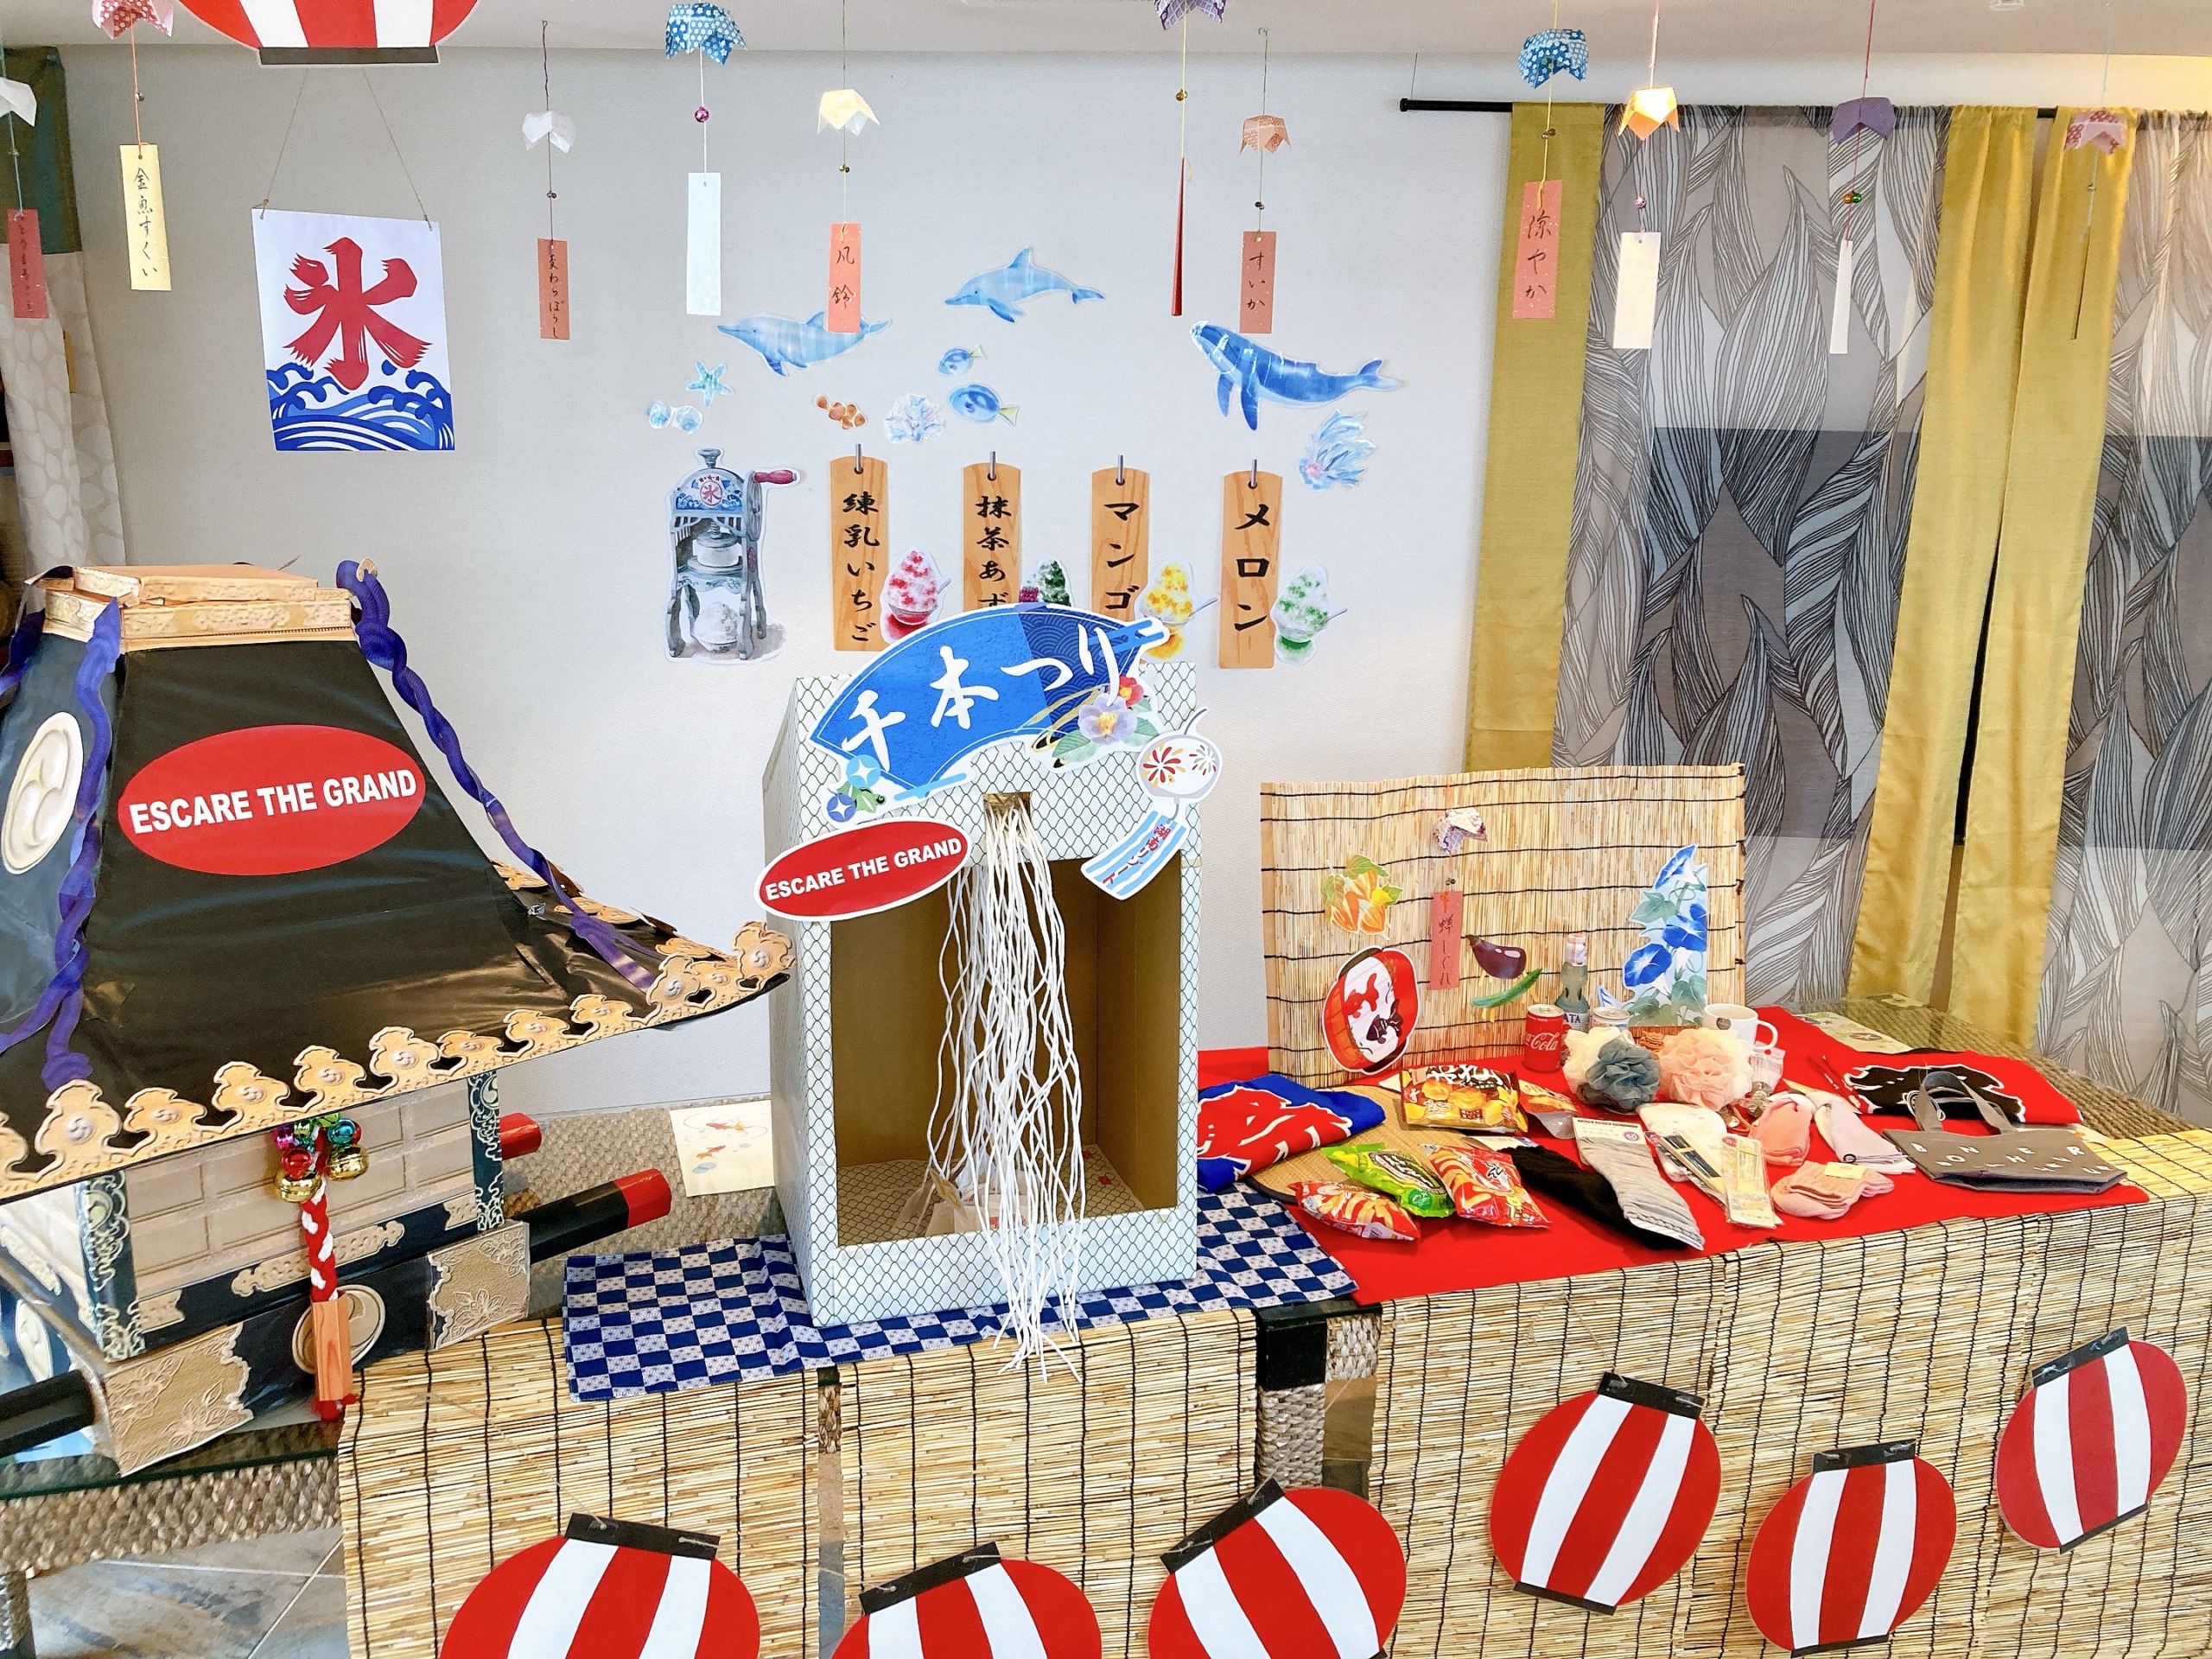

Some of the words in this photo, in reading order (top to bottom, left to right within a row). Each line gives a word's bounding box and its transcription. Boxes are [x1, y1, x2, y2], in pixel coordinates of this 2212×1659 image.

[134, 167, 158, 277] 金魚すくい
[1524, 208, 1552, 299] 涼やか
[283, 237, 434, 391] 氷
[1247, 251, 1266, 310] すいか
[842, 491, 880, 642] 練乳いちご
[1234, 503, 1270, 632] メロン
[841, 623, 1122, 772] 千本つり
[130, 790, 253, 834] ESCARE
[256, 782, 318, 817] THE
[322, 769, 417, 808] GRAND
[765, 868, 846, 901] ESCARE
[848, 855, 890, 880] THE
[893, 836, 963, 868] GRAND
